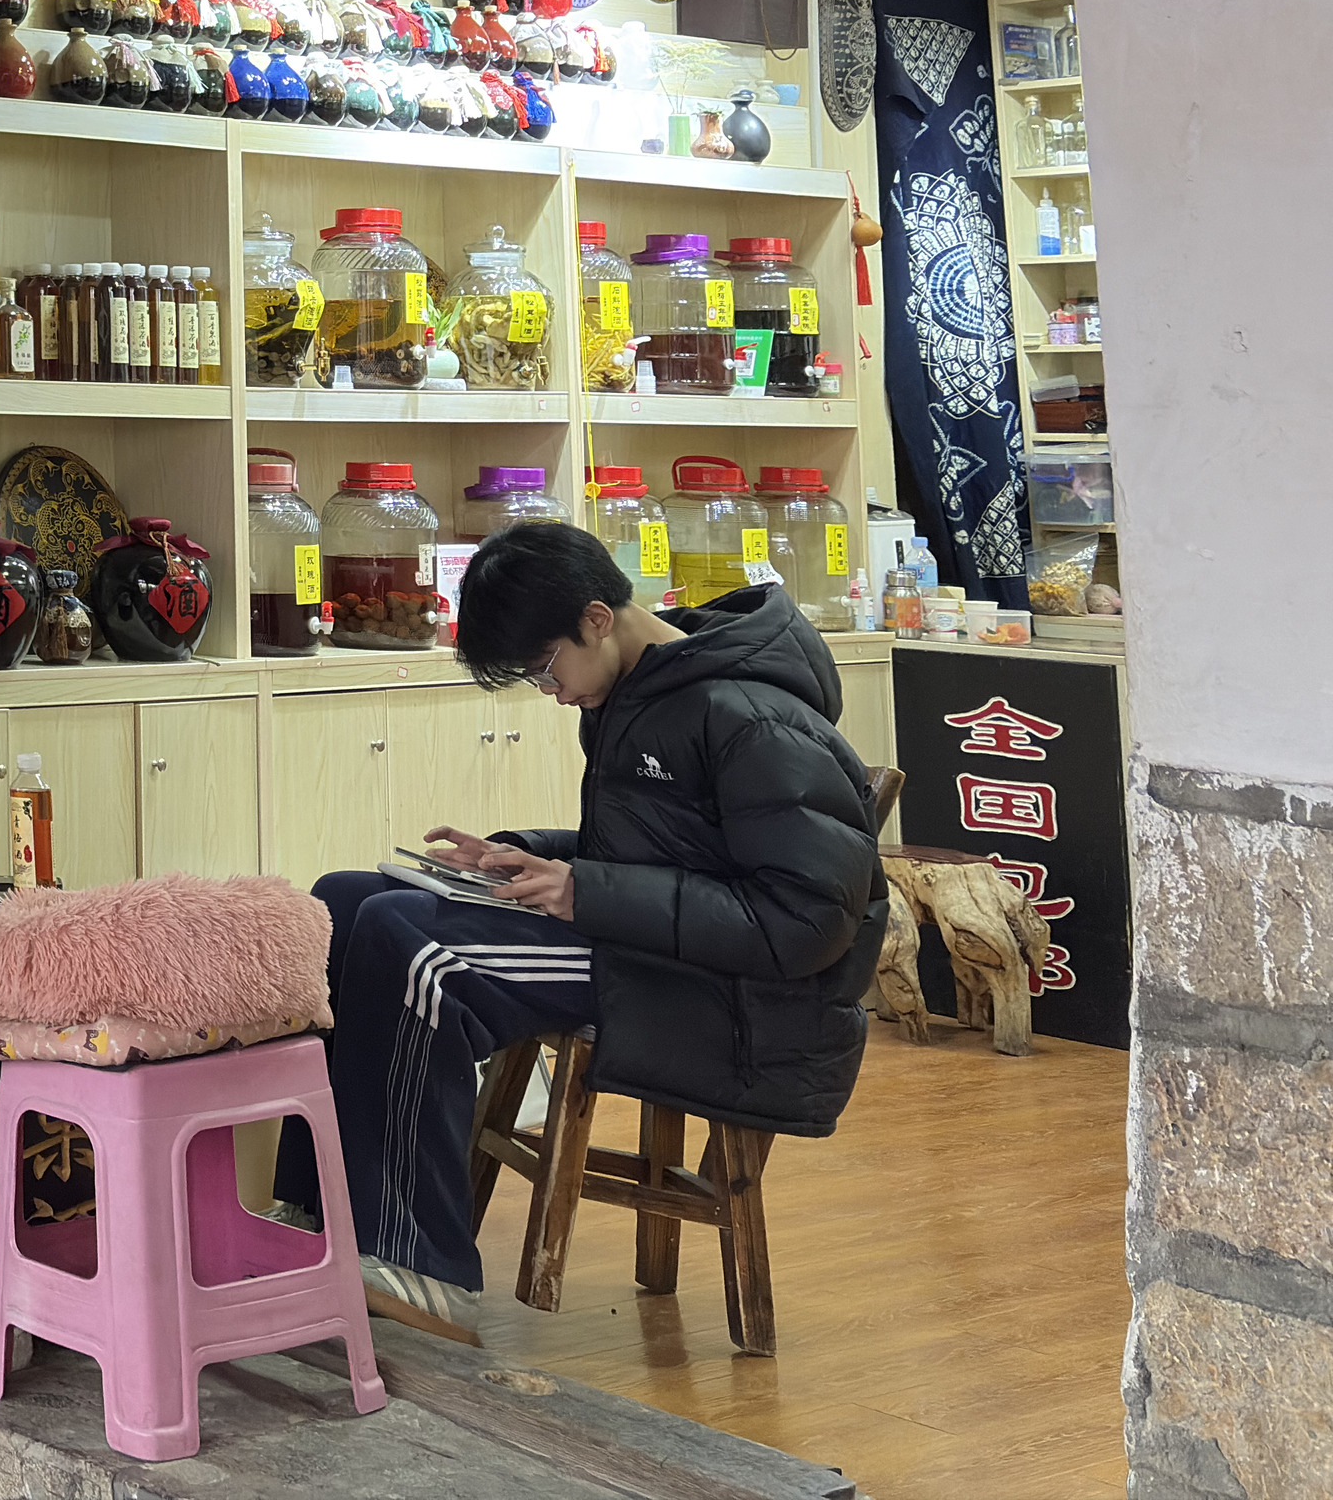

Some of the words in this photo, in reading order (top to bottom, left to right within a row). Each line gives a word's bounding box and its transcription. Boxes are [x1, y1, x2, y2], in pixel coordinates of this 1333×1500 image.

[754, 541, 762, 559] 三七
[163, 576, 200, 618] 酒
[636, 767, 675, 780] CAMEL
[13, 814, 23, 861] 青梅酒
